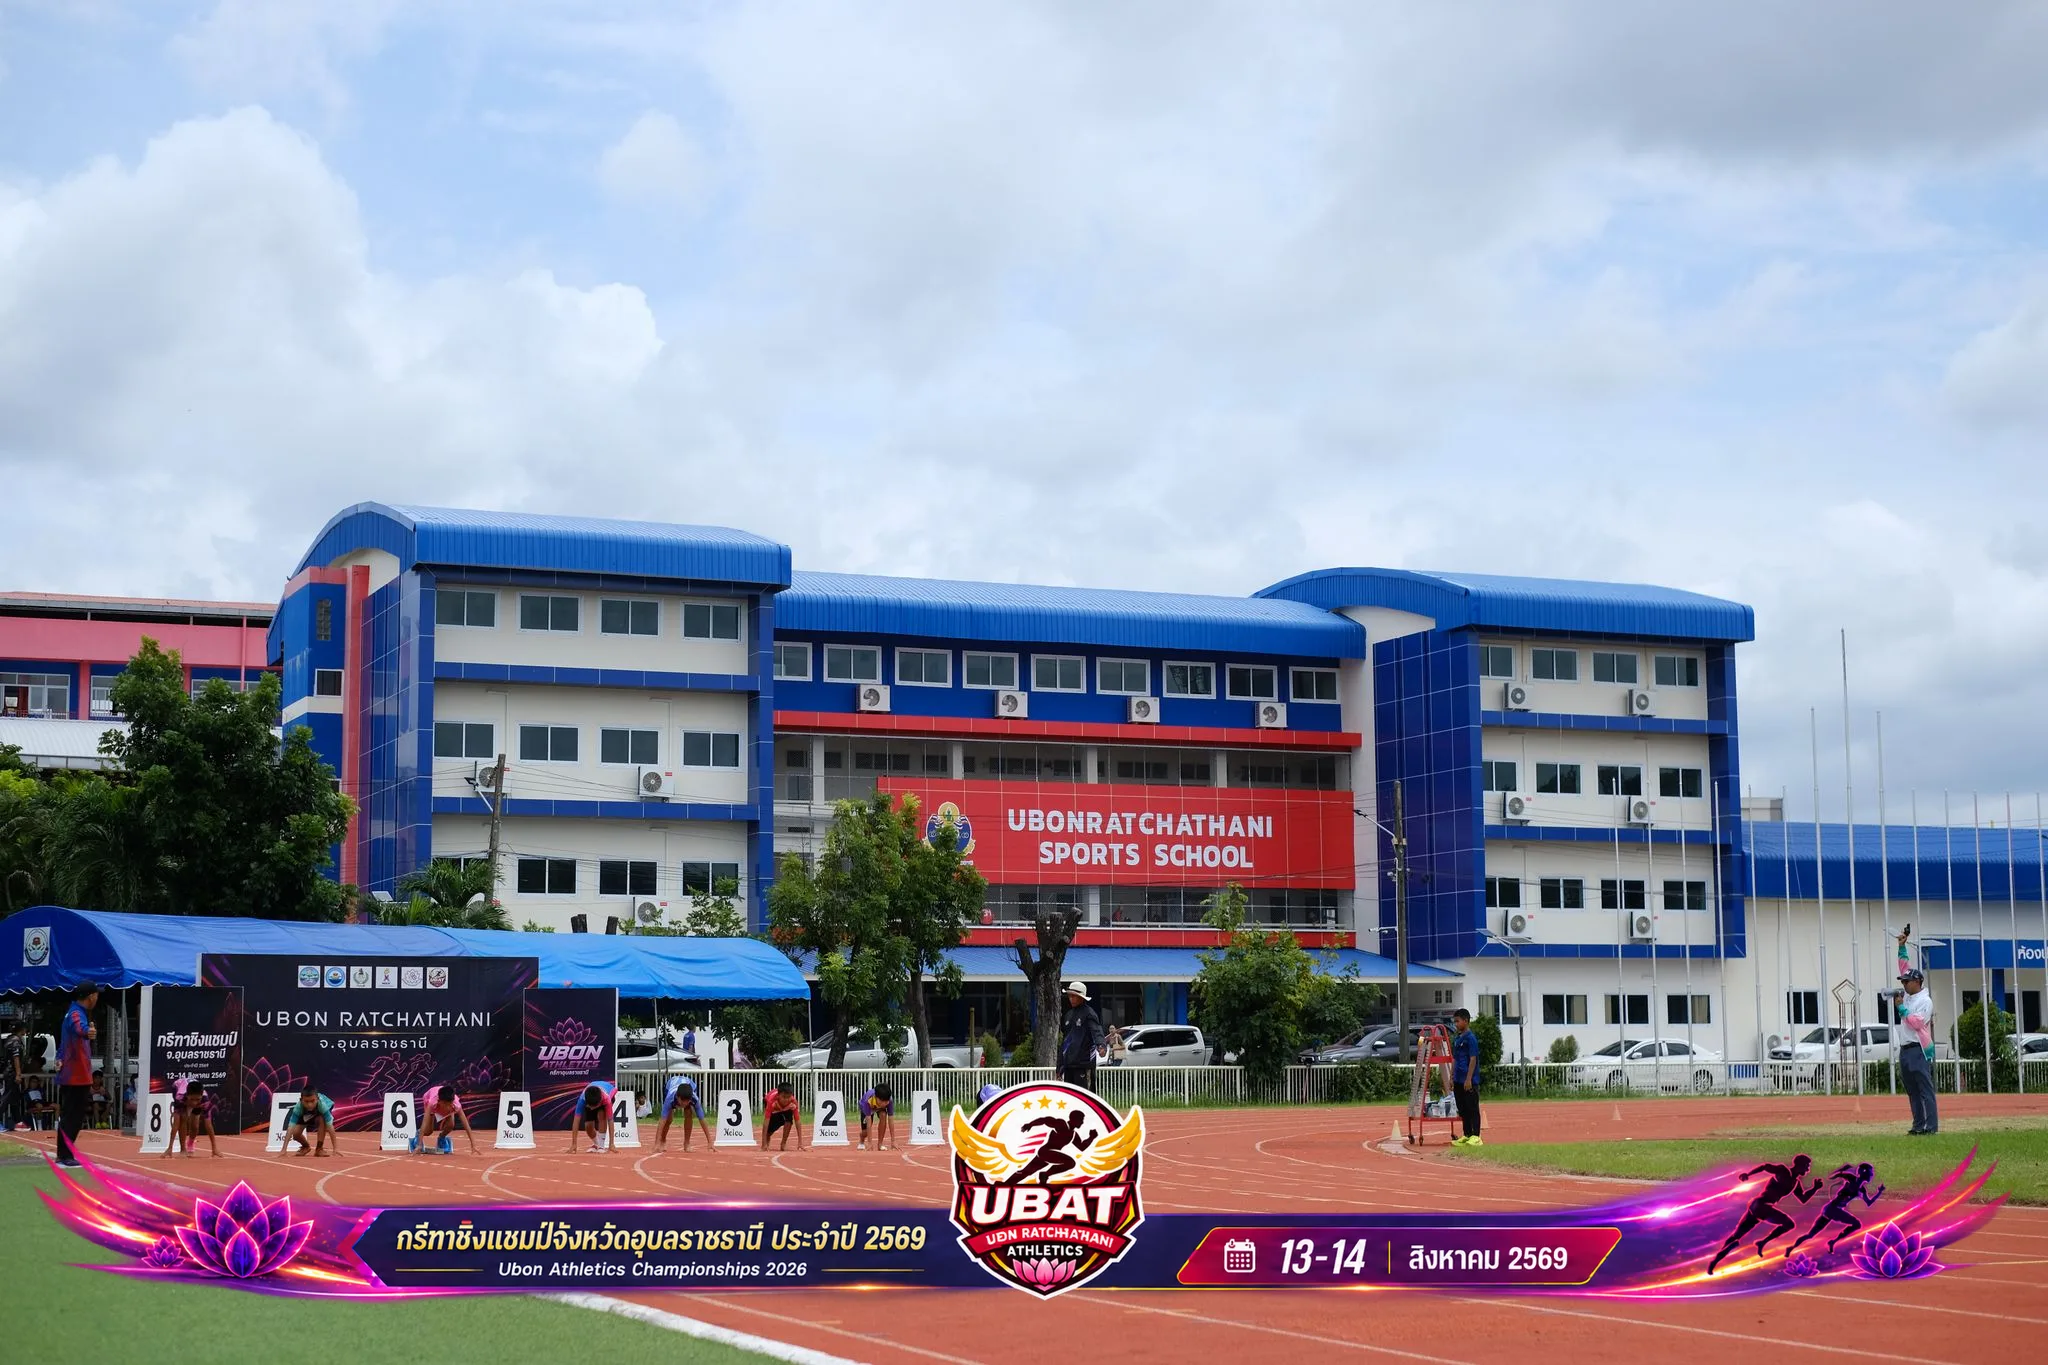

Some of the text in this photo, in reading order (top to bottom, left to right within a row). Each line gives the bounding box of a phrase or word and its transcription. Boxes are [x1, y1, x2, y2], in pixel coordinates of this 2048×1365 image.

[1007, 808, 1273, 838] UBONRATCHATHANI
[1039, 841, 1254, 868] SPORTS SCHOOL
[255, 1011, 491, 1028] UBON RATCHATHANI
[319, 1036, 428, 1053] จ.อุบลราชธานี
[538, 1045, 604, 1060] UBON
[539, 1060, 601, 1069] ATHLETICS
[151, 1103, 162, 1132] 8
[278, 1102, 298, 1131] 7
[390, 1100, 408, 1129] 6
[506, 1100, 523, 1128] 5
[613, 1100, 628, 1128] 4
[726, 1099, 743, 1127] 3
[821, 1100, 838, 1127] 2
[920, 1098, 932, 1126] 1
[614, 1130, 630, 1138] elco
